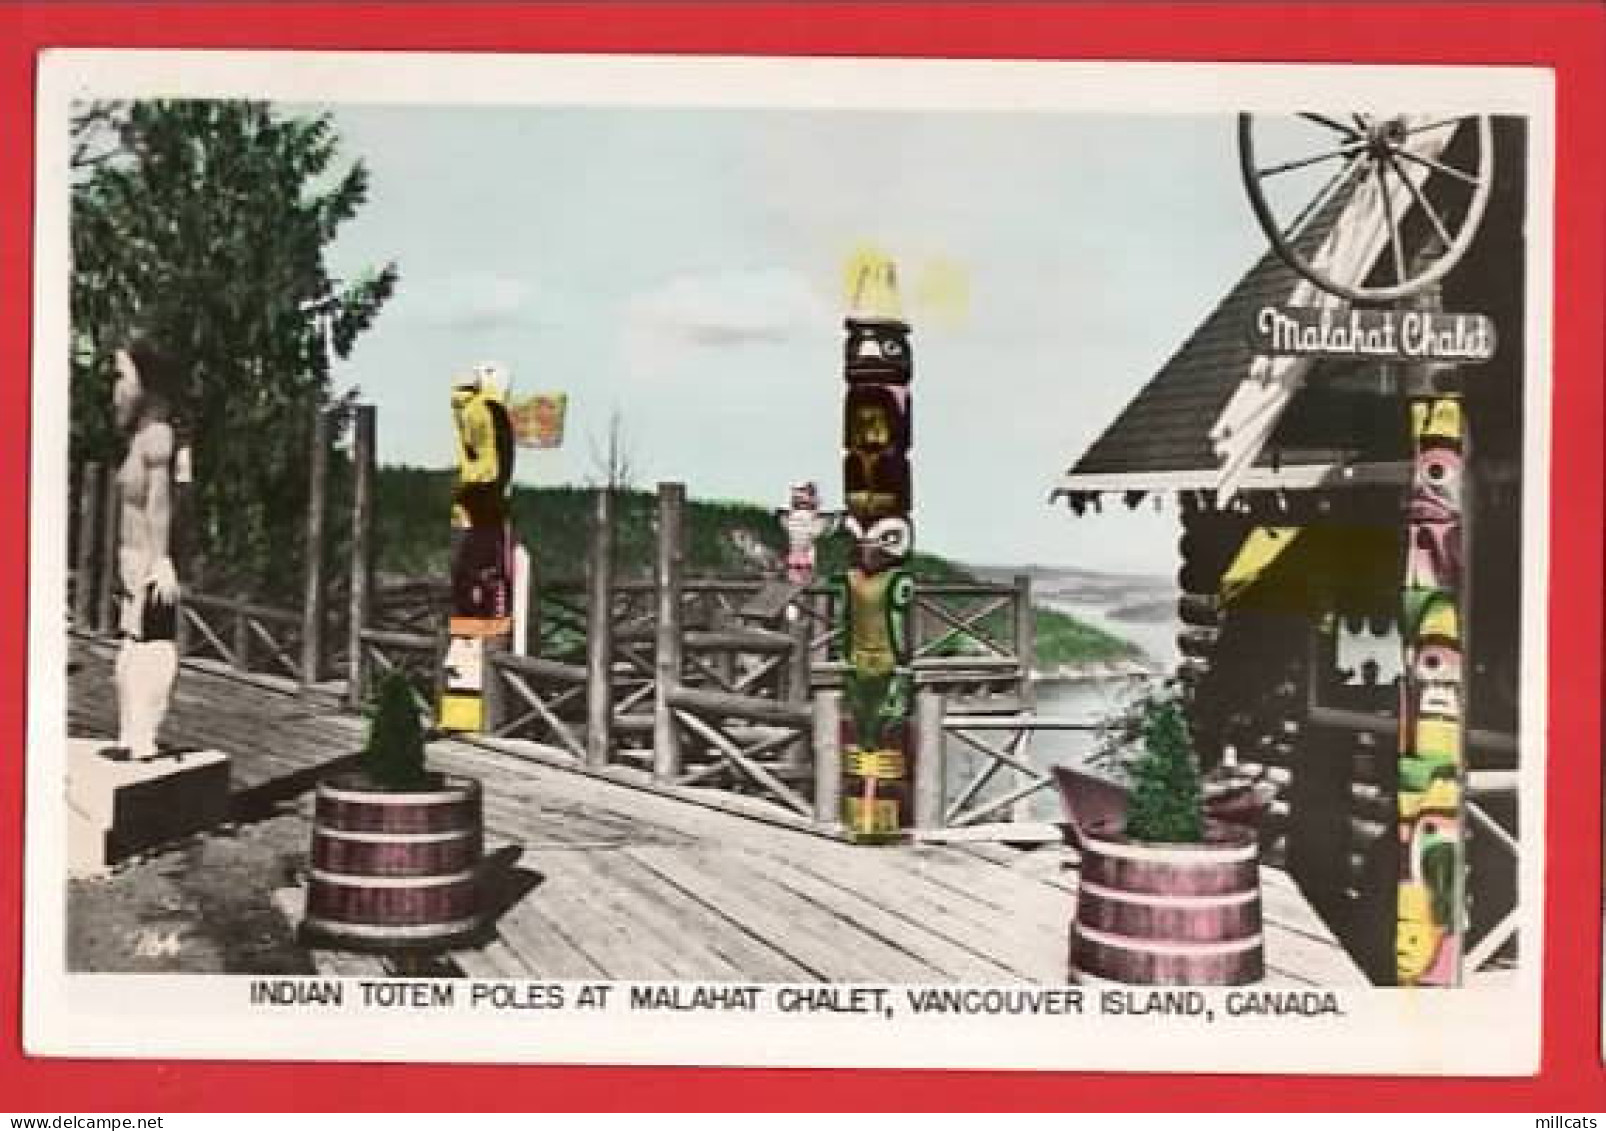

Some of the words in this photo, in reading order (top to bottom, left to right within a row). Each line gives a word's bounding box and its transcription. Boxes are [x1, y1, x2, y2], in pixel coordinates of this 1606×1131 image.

[1259, 307, 1397, 352] Malahat
[1402, 311, 1491, 356] Chalet
[250, 980, 343, 1008] INDIAN
[359, 981, 454, 1009] TOTEM
[470, 983, 565, 1010] POLES
[576, 985, 612, 1009] AT
[629, 985, 765, 1013] MALAHAT
[776, 988, 894, 1019] CHALET,
[906, 988, 1084, 1015] VANCOUVER
[1099, 991, 1215, 1022] ISLAND,
